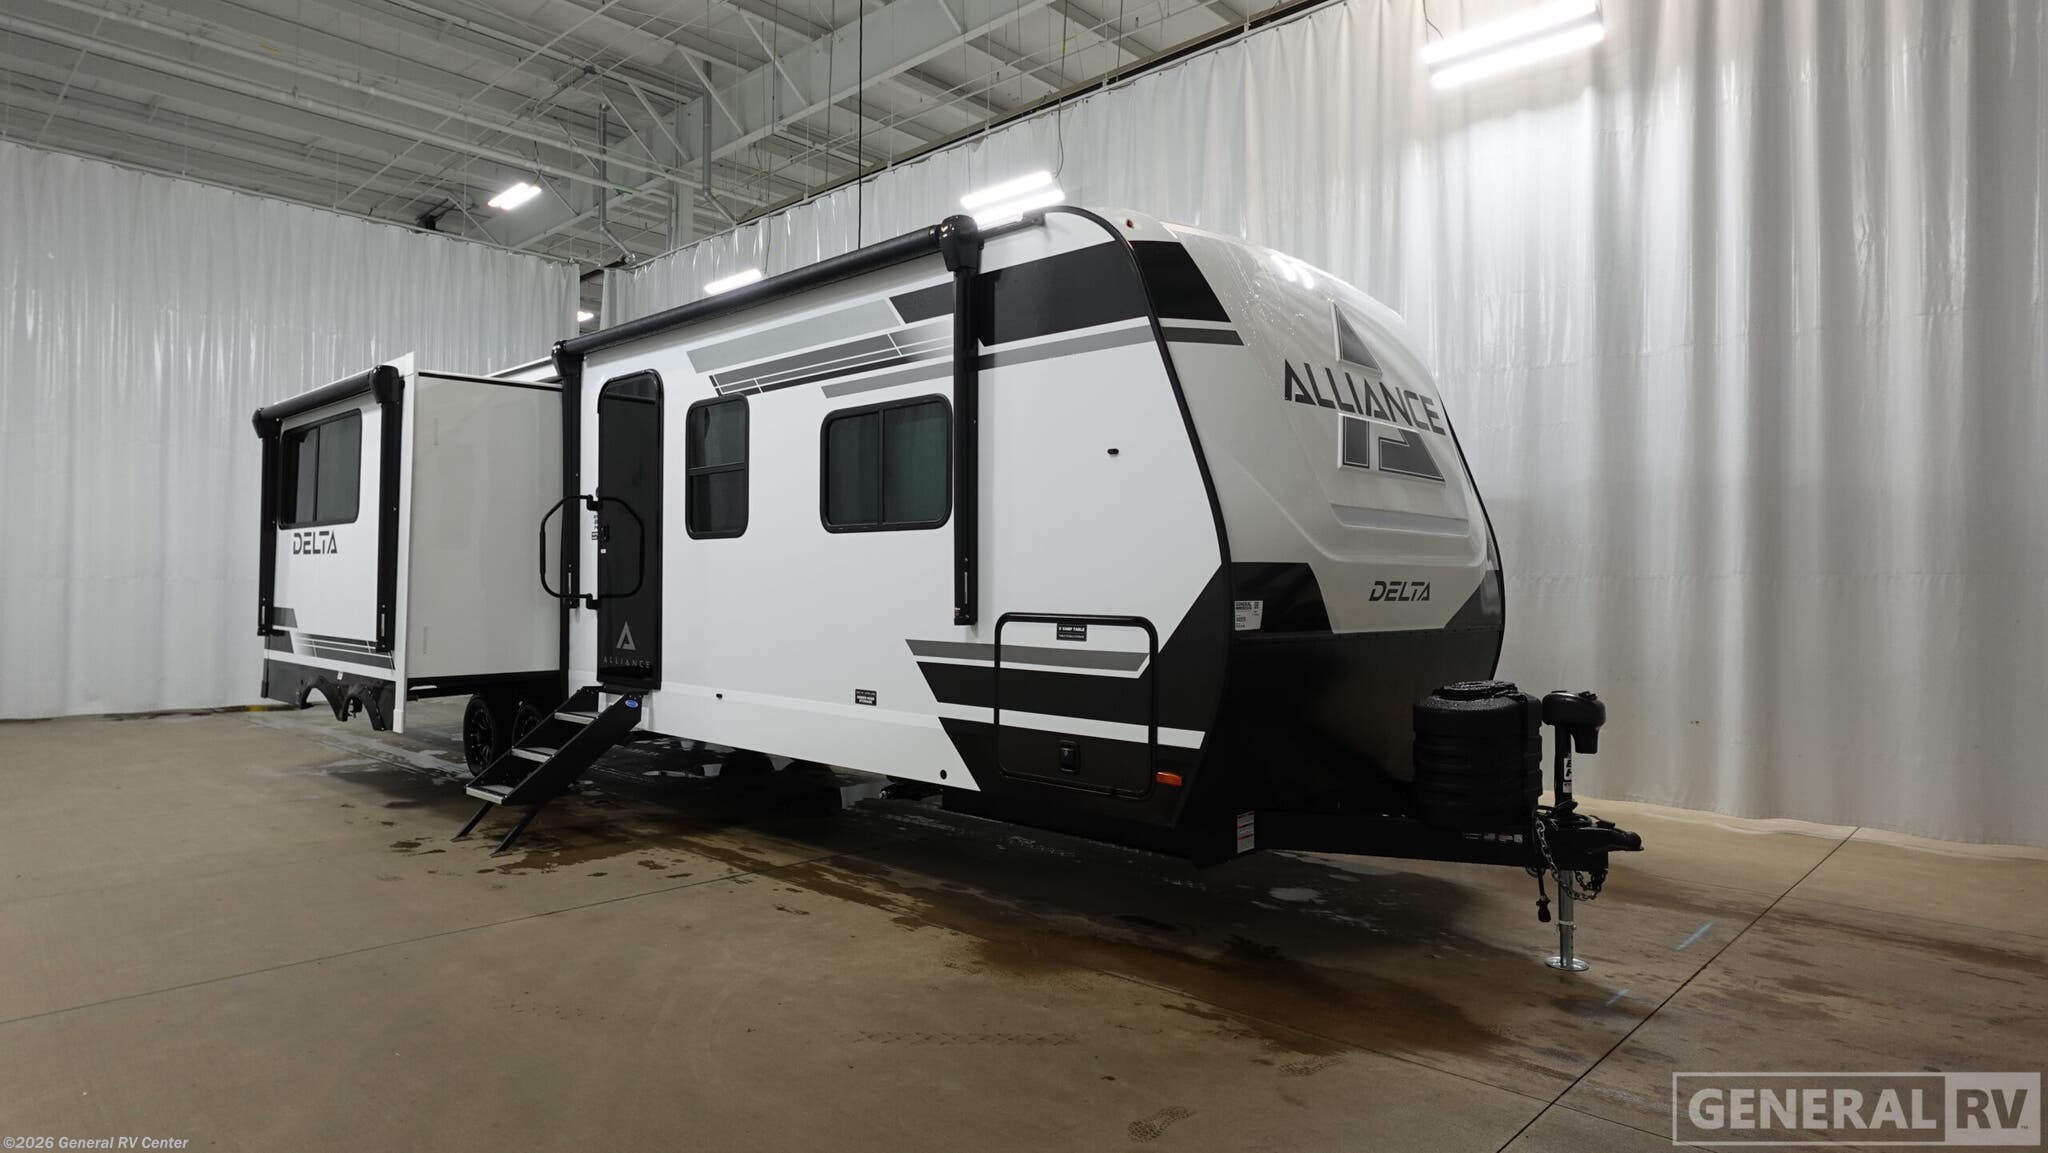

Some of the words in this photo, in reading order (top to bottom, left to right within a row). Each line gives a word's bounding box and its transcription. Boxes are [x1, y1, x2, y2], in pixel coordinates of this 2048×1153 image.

[1284, 358, 1447, 436] ALLIANCE
[293, 530, 338, 555] DELTA
[1369, 580, 1431, 602] DELTA
[603, 655, 652, 669] ALLIANCE
